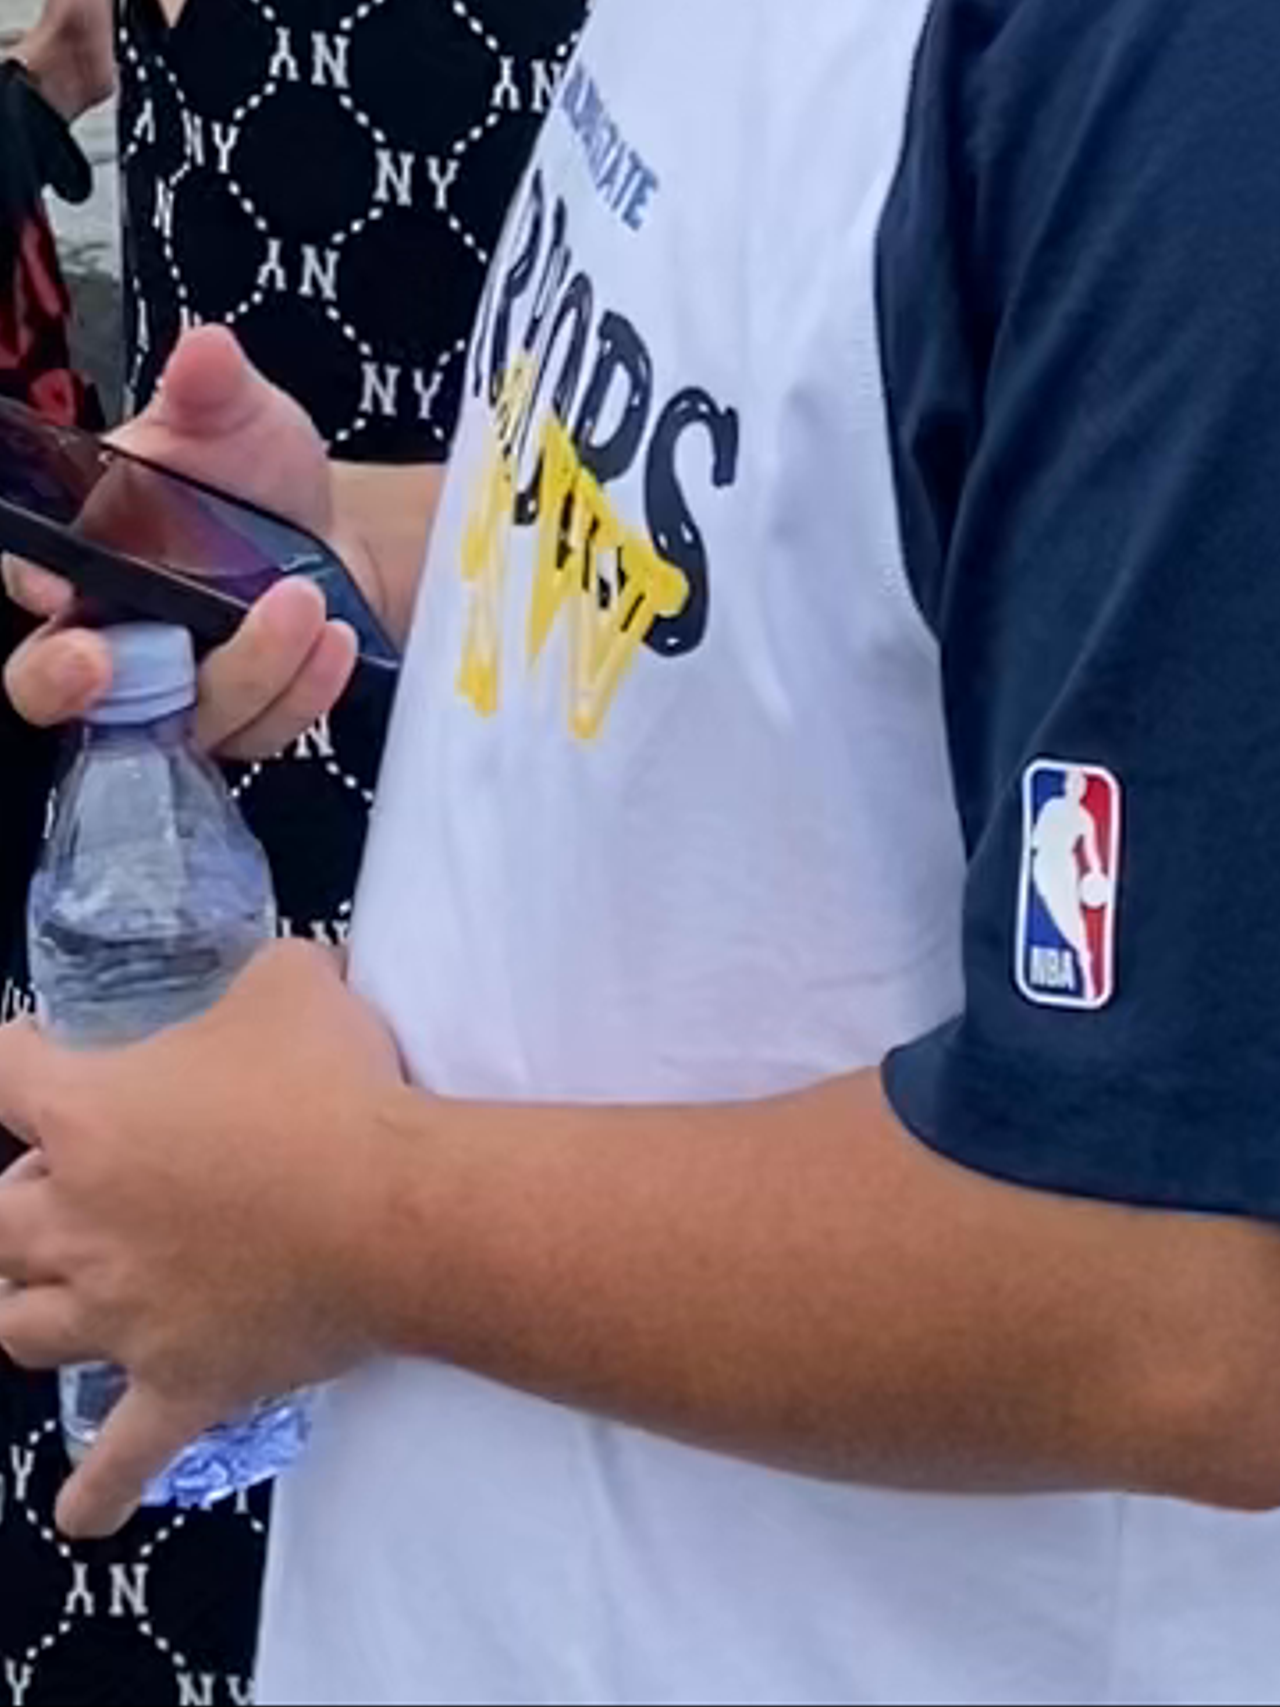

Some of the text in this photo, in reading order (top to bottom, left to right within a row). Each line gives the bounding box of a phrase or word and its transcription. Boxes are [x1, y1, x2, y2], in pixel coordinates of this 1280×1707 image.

[373, 149, 459, 210] NY
[360, 362, 444, 419] NY
[1030, 947, 1076, 991] NBA
